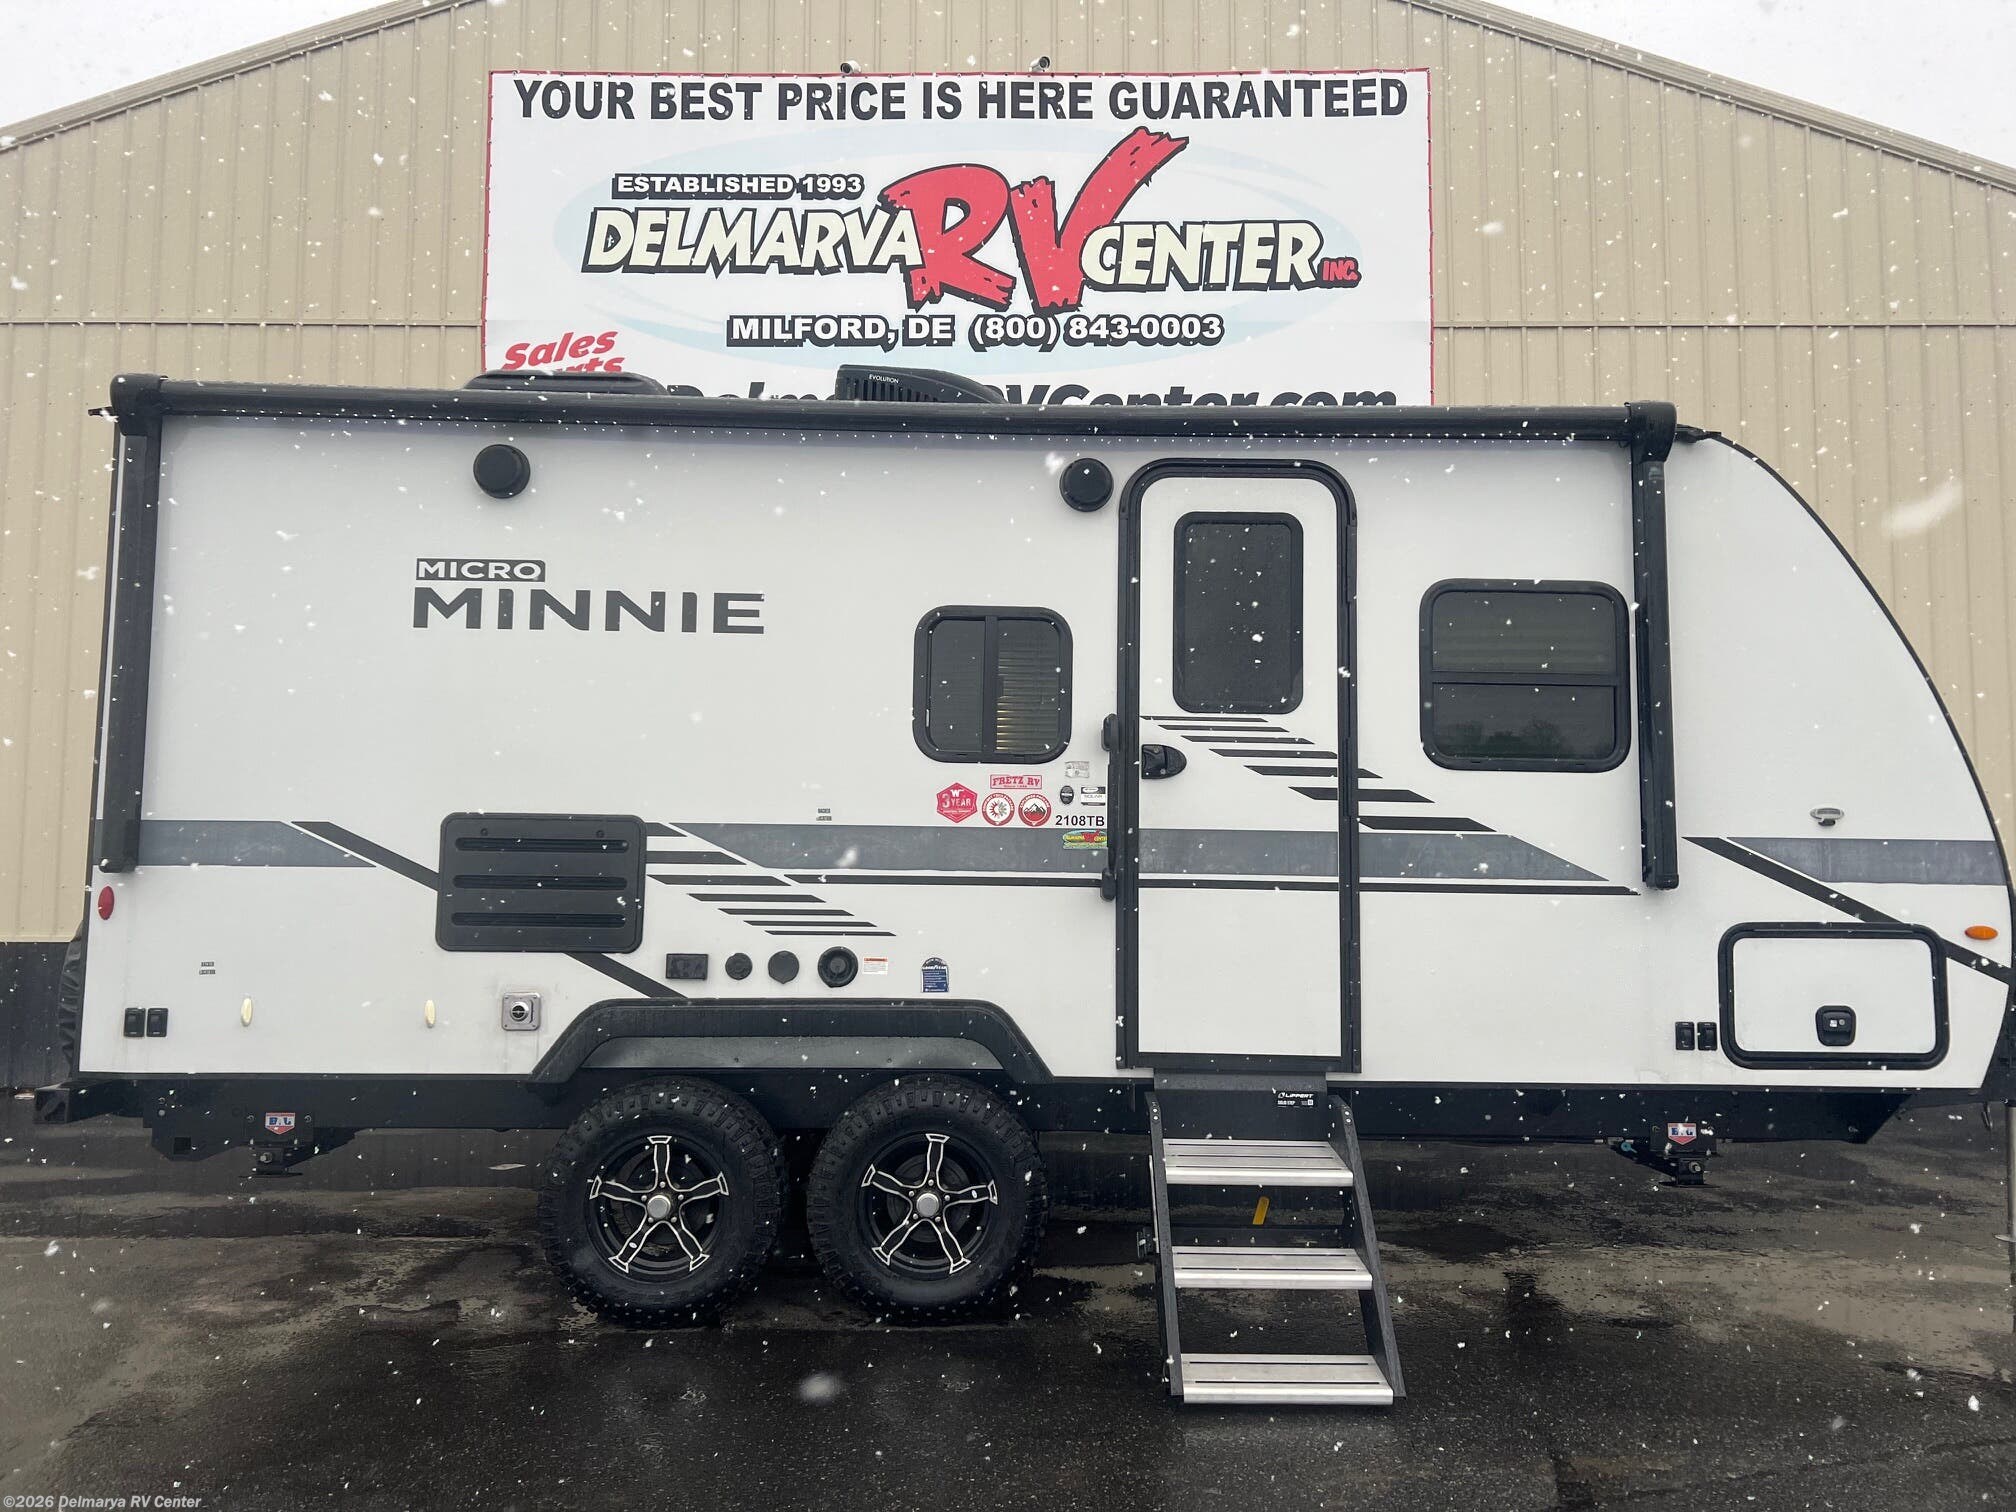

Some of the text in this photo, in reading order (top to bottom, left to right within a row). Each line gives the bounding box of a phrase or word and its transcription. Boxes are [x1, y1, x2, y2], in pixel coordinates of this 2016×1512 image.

[514, 78, 1408, 121] YOUR BEST PRICE IS HERE GUARANTEED
[614, 174, 864, 198] ESTABLISHED 1993
[581, 206, 925, 278] DELMARVA
[877, 126, 1189, 312] RV
[1080, 219, 1324, 292] CENTER
[727, 315, 1224, 352] MILFORD, DE (800) 843-0003
[502, 331, 618, 371] Sales
[418, 560, 542, 580] MICRO
[413, 587, 765, 635] MINNIE
[992, 775, 1041, 787] FRETZ RV
[941, 793, 951, 809] 3
[951, 797, 972, 807] YEAR
[1055, 814, 1105, 827] 2108TB
